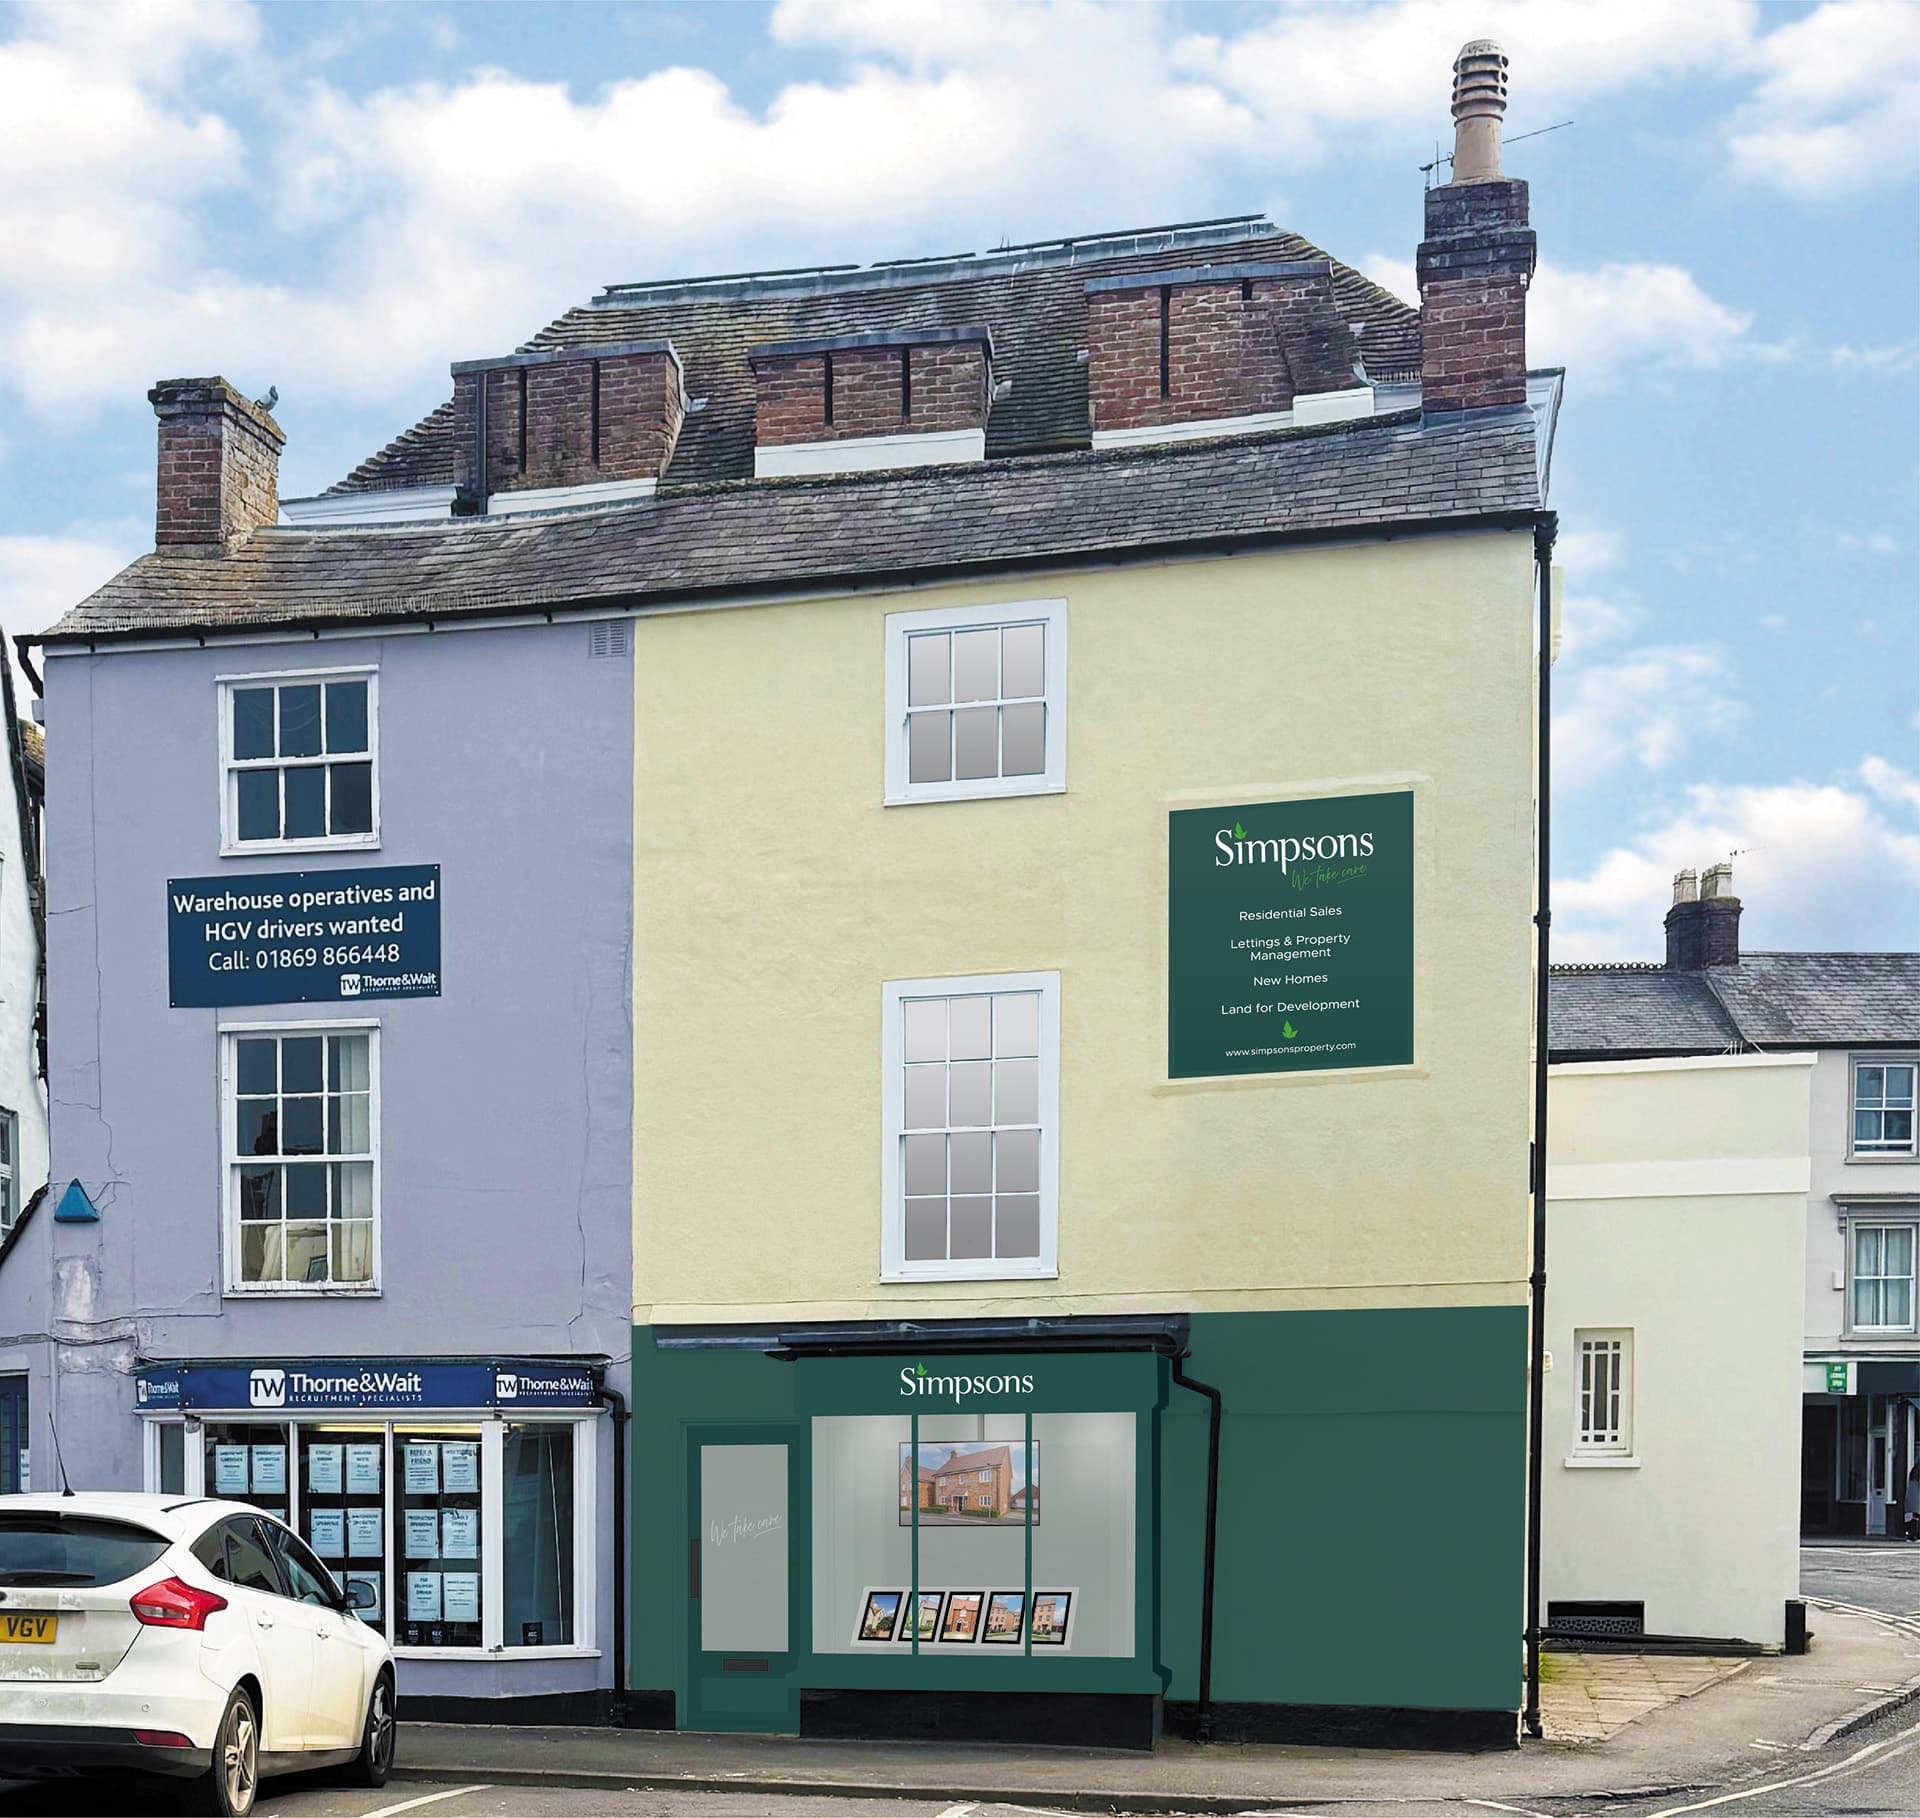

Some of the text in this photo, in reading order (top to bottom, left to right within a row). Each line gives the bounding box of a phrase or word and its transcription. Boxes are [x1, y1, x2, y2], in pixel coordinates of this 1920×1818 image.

[1215, 823, 1374, 876] Simpsons
[1291, 864, 1367, 891] We take care
[173, 880, 435, 913] Warehouse operatives and
[1239, 906, 1342, 921] Residential Sales
[205, 912, 403, 942] HGV drivers wanted
[1230, 933, 1351, 950] Lettings & Property
[208, 943, 400, 971] Call: 01869 866448
[1250, 947, 1331, 962] Management
[362, 973, 437, 987] Thorne&Wait
[1253, 973, 1328, 987] New Homes
[1221, 999, 1360, 1015] Land for Development
[1225, 1041, 1356, 1058] www.simpsonsproperty.com
[289, 1372, 422, 1393] Thorne&Wait
[519, 1377, 594, 1391] Thorne&Wait
[901, 1363, 1034, 1405] Simpsons
[289, 1394, 422, 1402] RECRUITMENT SPECIALISTS
[7, 1617, 48, 1638] VGV
